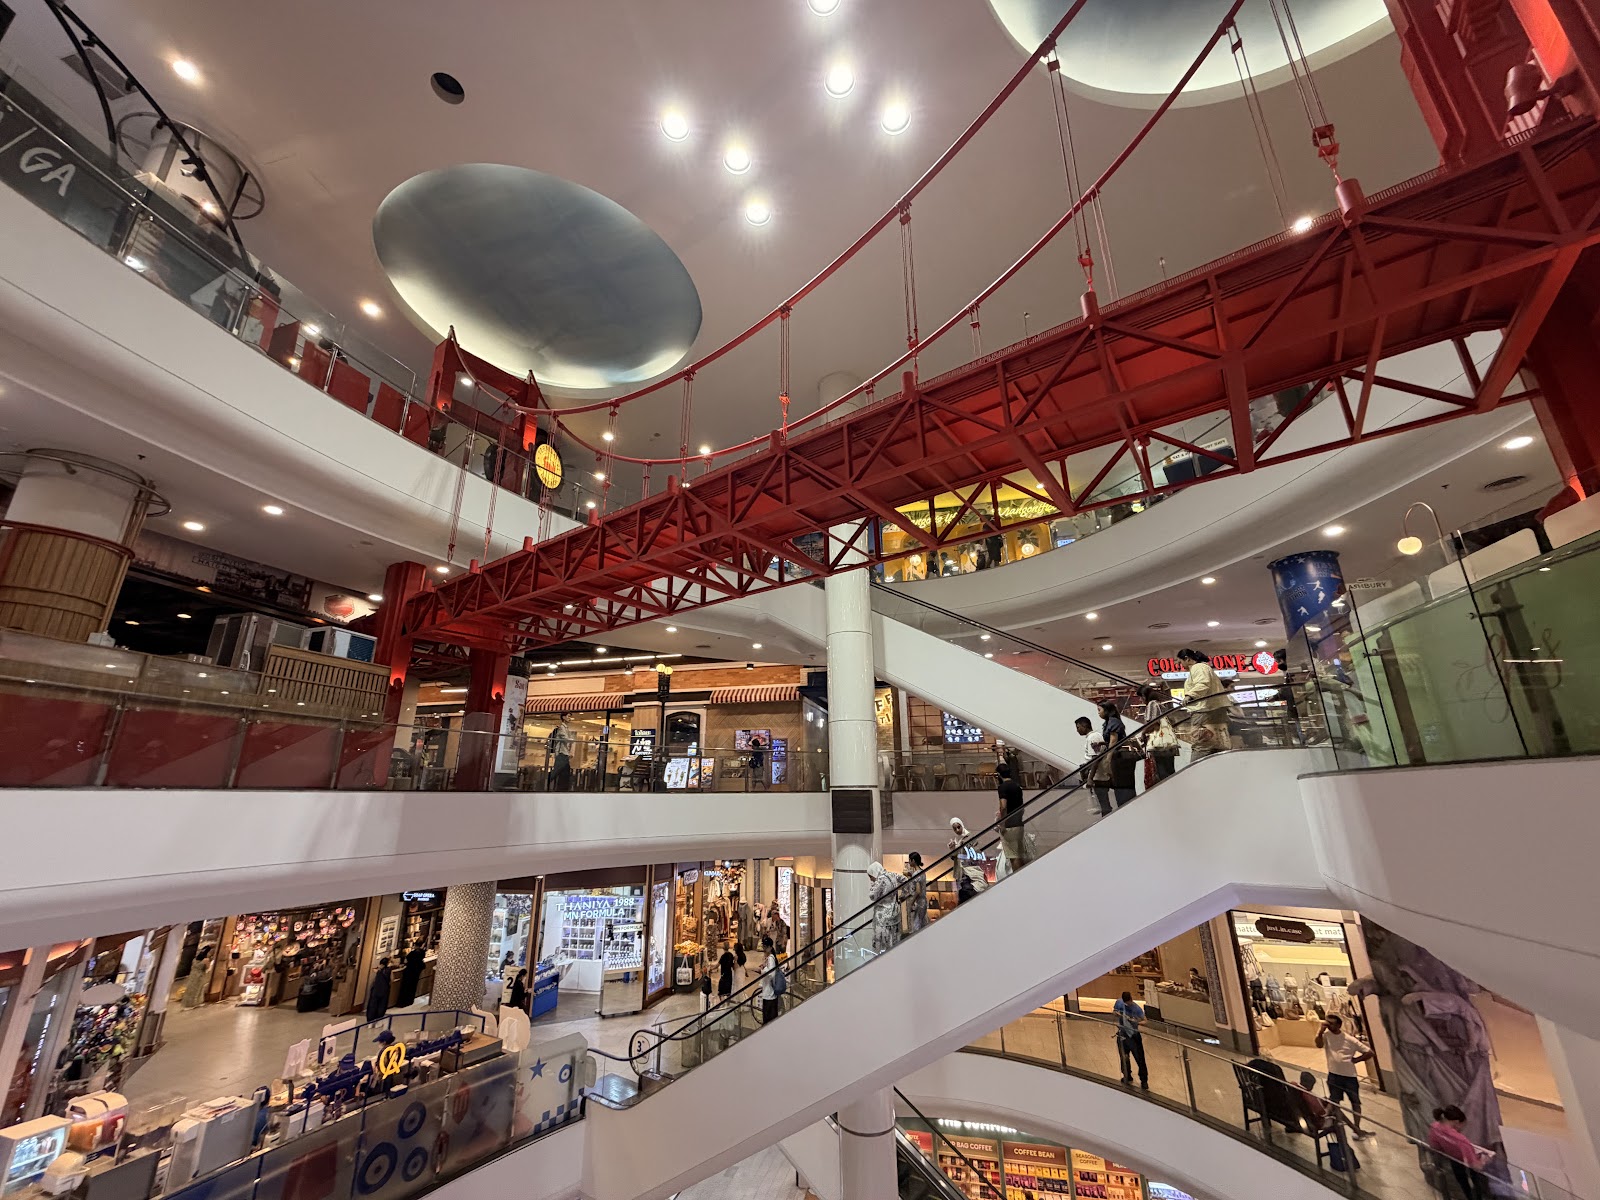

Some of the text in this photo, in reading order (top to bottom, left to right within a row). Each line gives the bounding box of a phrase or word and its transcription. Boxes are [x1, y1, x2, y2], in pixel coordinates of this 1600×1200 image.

[1348, 582, 1386, 590] ASHBURY
[1147, 653, 1249, 677] COL ONE
[613, 898, 634, 907] 1988
[581, 907, 625, 919] FORMULA
[969, 1143, 993, 1151] COFFEE
[1014, 1148, 1055, 1159] COFFEE BEAN
